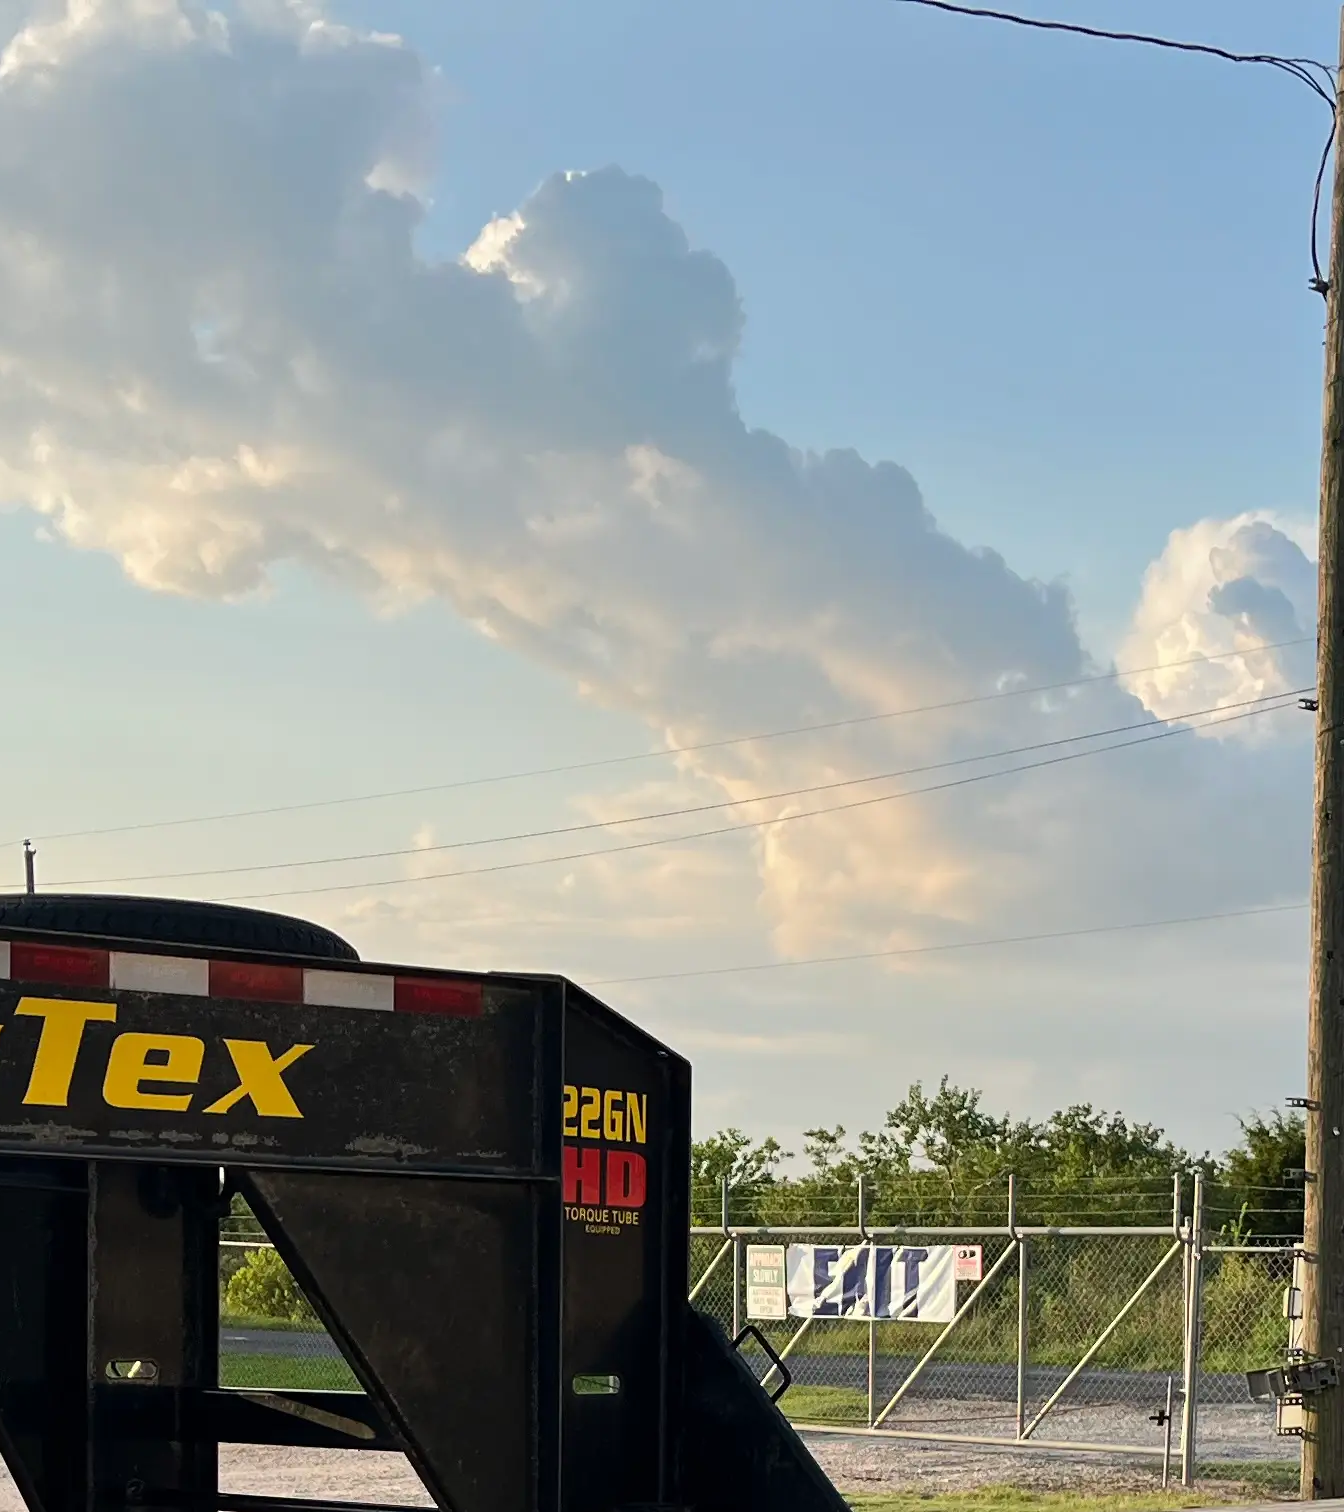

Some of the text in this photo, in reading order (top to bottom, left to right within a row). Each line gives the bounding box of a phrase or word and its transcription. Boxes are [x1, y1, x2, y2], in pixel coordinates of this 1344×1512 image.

[562, 1084, 648, 1144] 22GN
[562, 1146, 647, 1208] HD
[564, 1206, 640, 1226] TORQUE TUBE
[584, 1224, 621, 1236] EQUIPPED
